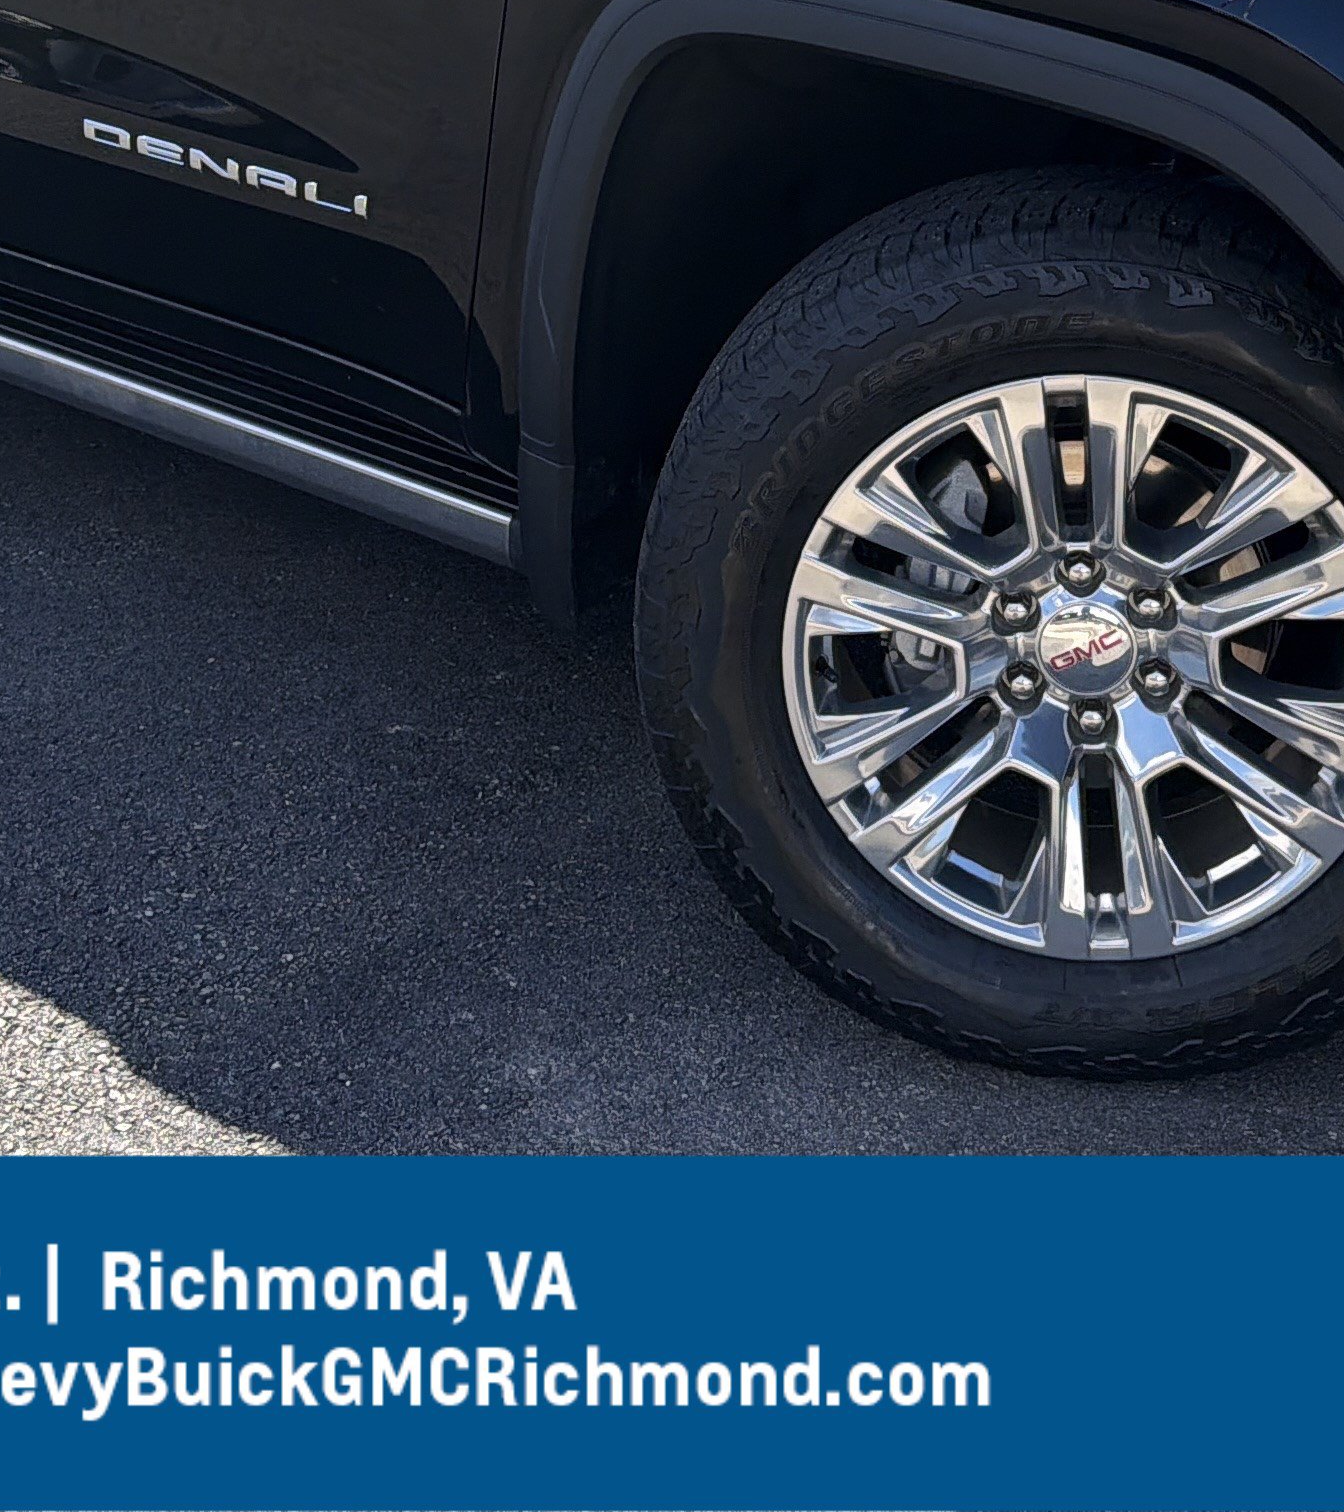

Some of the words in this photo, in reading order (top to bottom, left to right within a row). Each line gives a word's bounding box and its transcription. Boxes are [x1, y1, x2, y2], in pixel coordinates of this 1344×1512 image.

[82, 117, 369, 220] DENALI
[732, 311, 1096, 558] BRIDGESTONE
[1049, 628, 1124, 672] GMC
